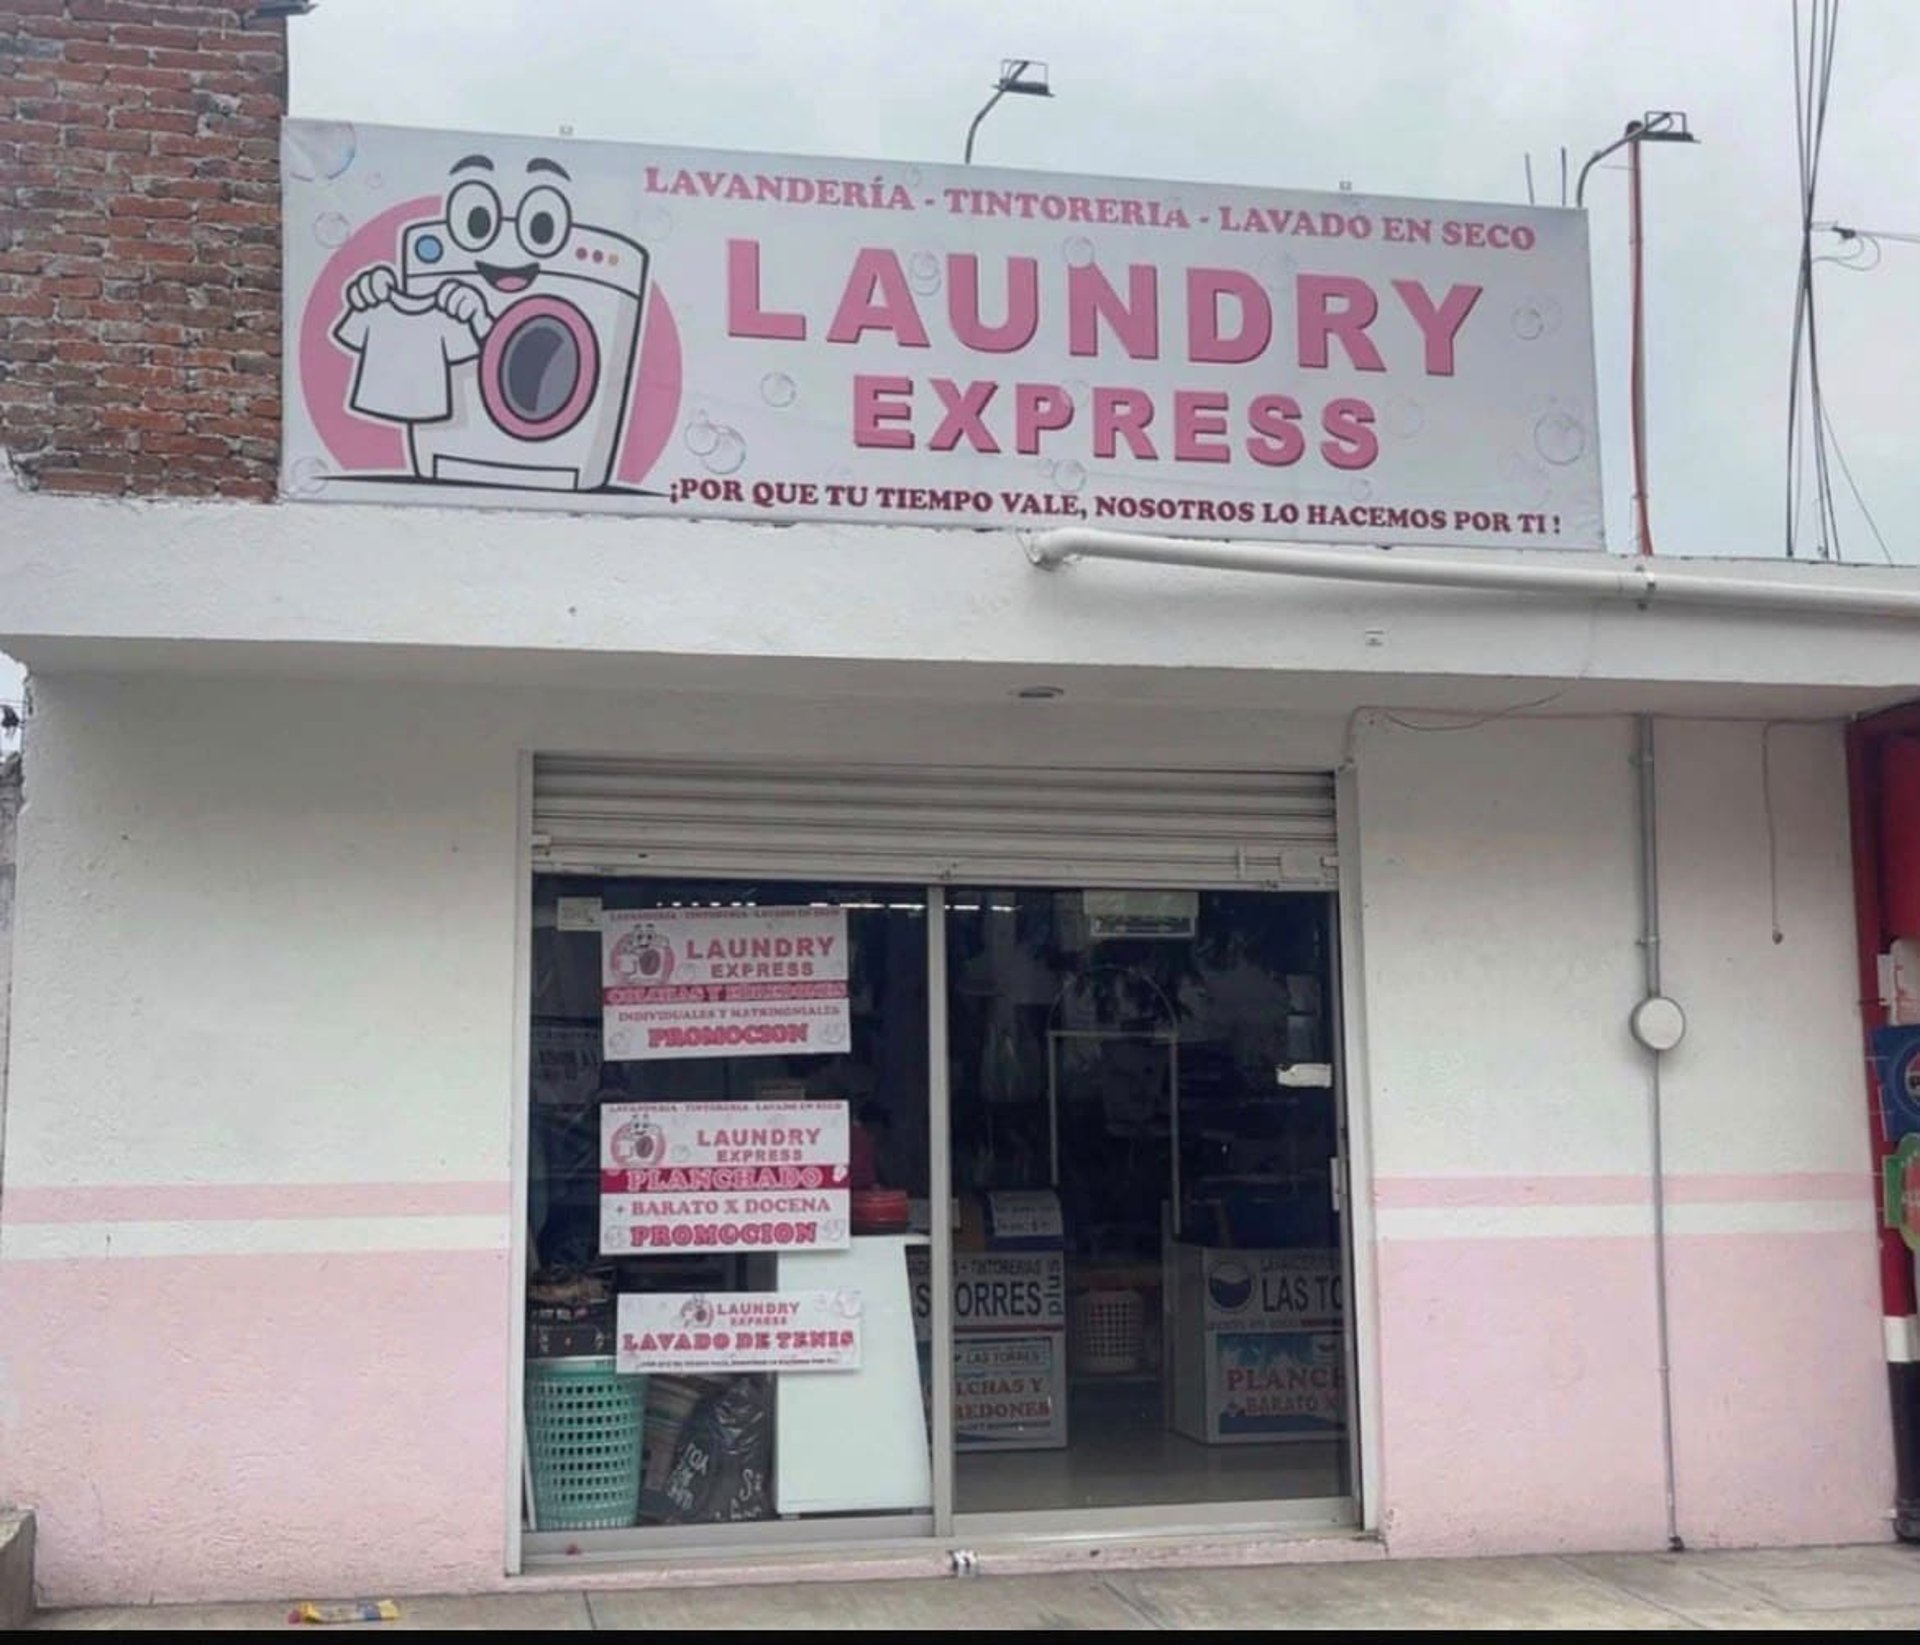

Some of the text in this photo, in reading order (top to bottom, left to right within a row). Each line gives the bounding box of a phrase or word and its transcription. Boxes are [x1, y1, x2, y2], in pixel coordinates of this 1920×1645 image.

[644, 166, 915, 211] LAVANDERÍA
[945, 188, 1190, 230] TINTORERIA
[1219, 206, 1372, 241] LAVADO
[1382, 217, 1433, 246] EN
[1441, 221, 1536, 252] SECO
[727, 238, 1483, 377] LAUNDRY
[852, 374, 1380, 470] EXPRESS
[751, 484, 819, 510] QUE
[826, 487, 869, 508] TU
[876, 488, 993, 515] TIEMPO
[1000, 492, 1088, 522] VALE,
[1094, 495, 1255, 524] NOSOTROS
[1262, 503, 1299, 526] LO
[1306, 504, 1447, 531] HACEMOS
[1453, 511, 1510, 535] POR
[1516, 514, 1547, 535] TI
[685, 936, 836, 960] LAUNDRY
[710, 961, 815, 979] EXPRESS
[697, 1127, 822, 1147] LAUNDRY
[716, 1149, 804, 1163] EXPRESS
[627, 1166, 824, 1192] PLANCHADO
[632, 1200, 719, 1216] BARATO
[724, 1198, 740, 1214] X
[745, 1197, 831, 1214] DOCENA
[630, 1221, 818, 1247] PROMOCION
[954, 1281, 1042, 1317] ORRES
[1262, 1275, 1309, 1313] LAS
[716, 1301, 801, 1316] LAUNDRY
[622, 1329, 854, 1352] LAVADO DE TENIS
